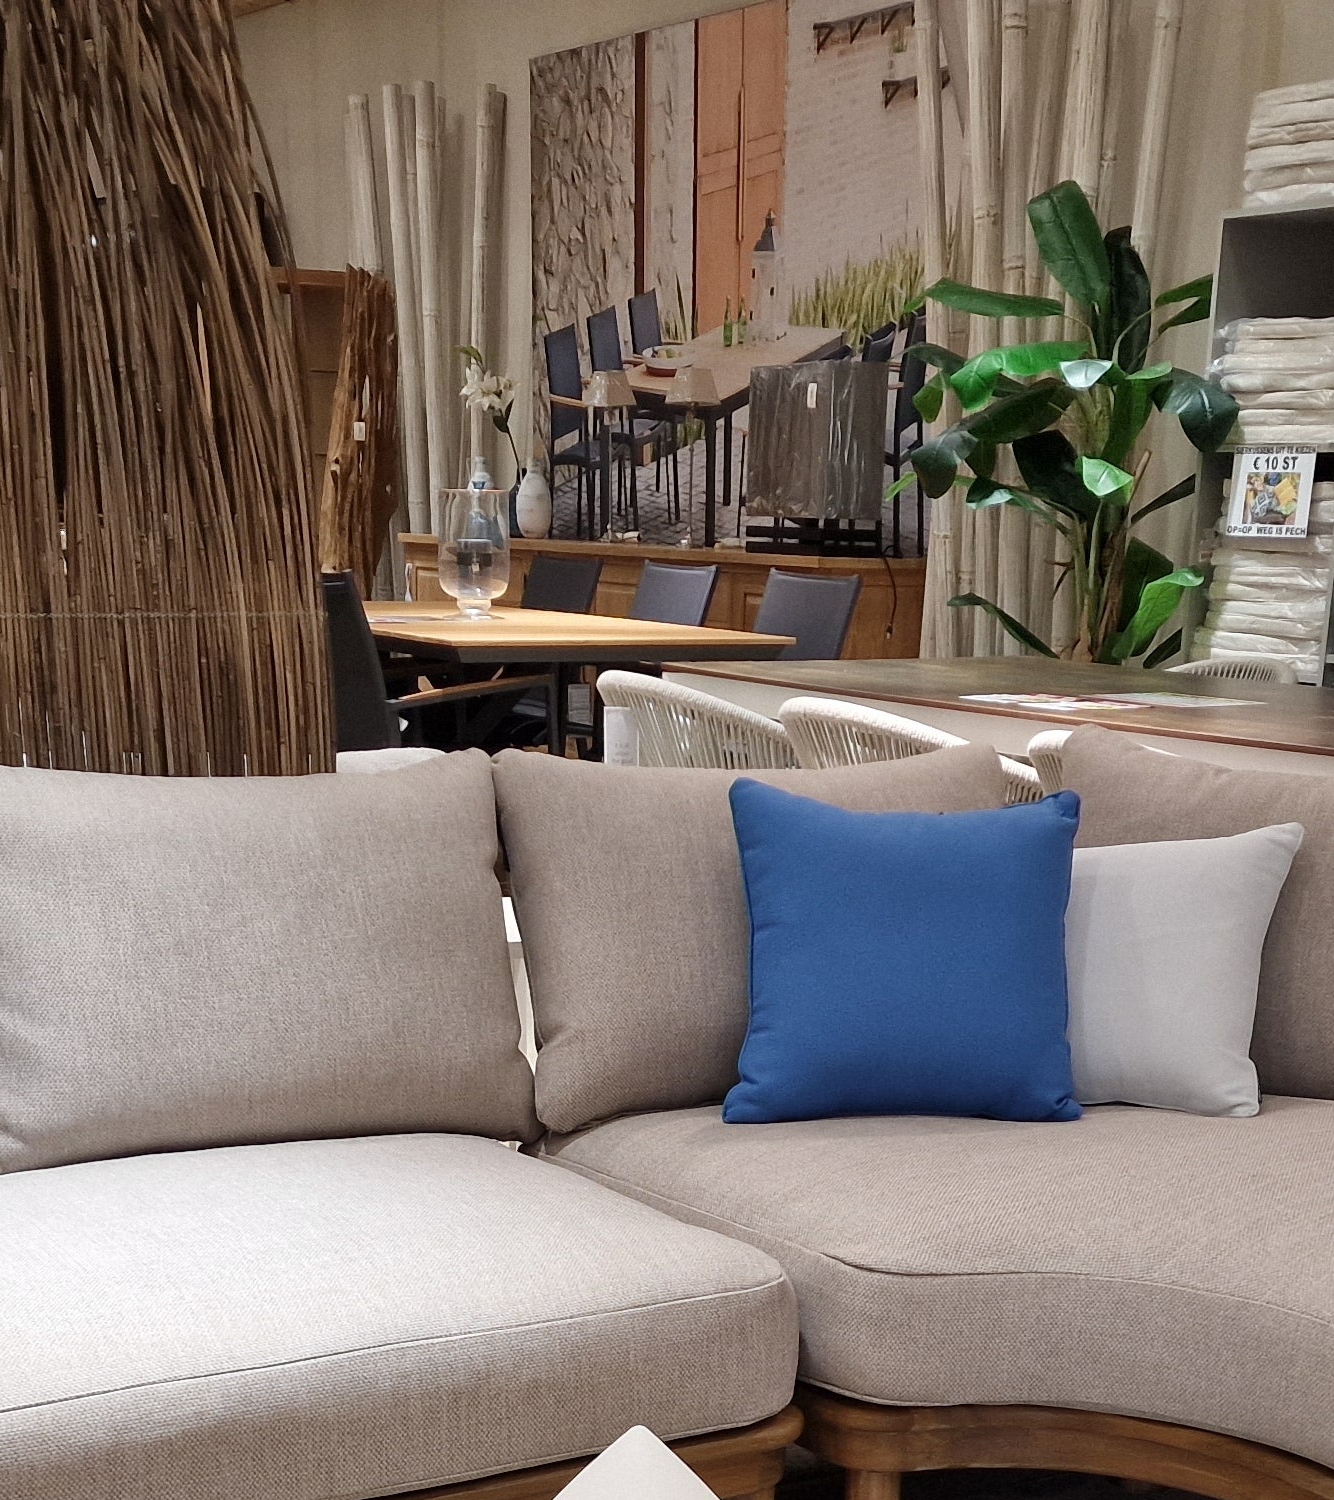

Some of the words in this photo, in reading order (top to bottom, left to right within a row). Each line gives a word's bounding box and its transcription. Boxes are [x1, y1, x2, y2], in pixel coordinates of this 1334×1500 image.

[1253, 456, 1261, 470] €
[1265, 456, 1279, 470] 10
[1282, 455, 1299, 470] ST
[1227, 525, 1253, 535] OP=OP
[1256, 526, 1274, 536] WEG
[1275, 526, 1284, 536] IS
[1285, 526, 1306, 537] PECH
